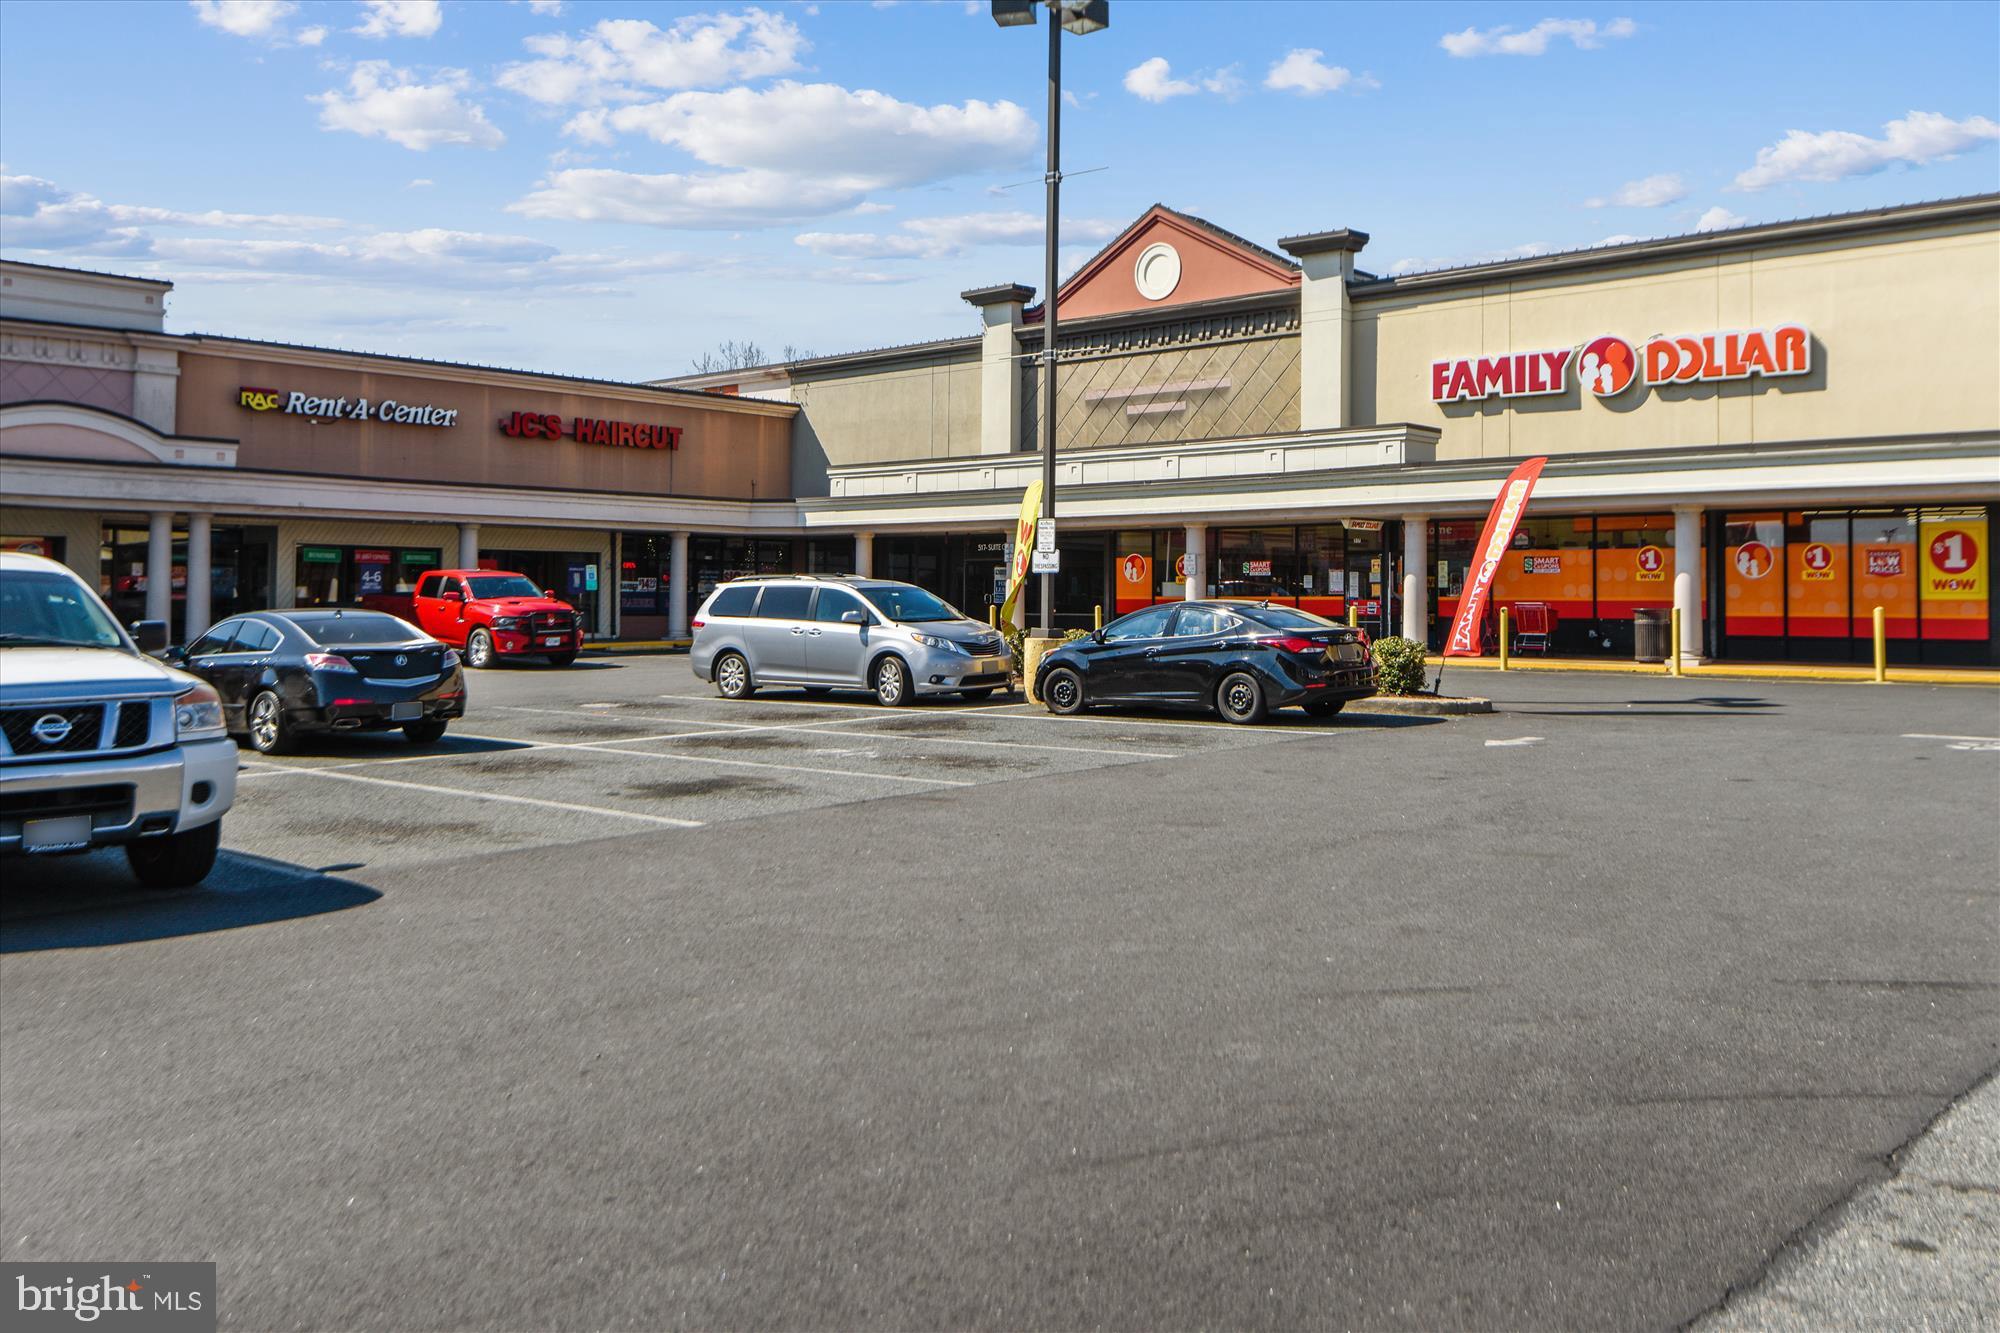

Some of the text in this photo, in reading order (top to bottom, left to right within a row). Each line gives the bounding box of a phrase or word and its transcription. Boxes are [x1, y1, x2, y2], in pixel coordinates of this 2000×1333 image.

[1433, 327, 1807, 401] FAMILY DOLLAR
[241, 391, 279, 411] RAC
[505, 411, 684, 451] JC'S HAIRCUT
[1933, 579, 1976, 590] WOW
